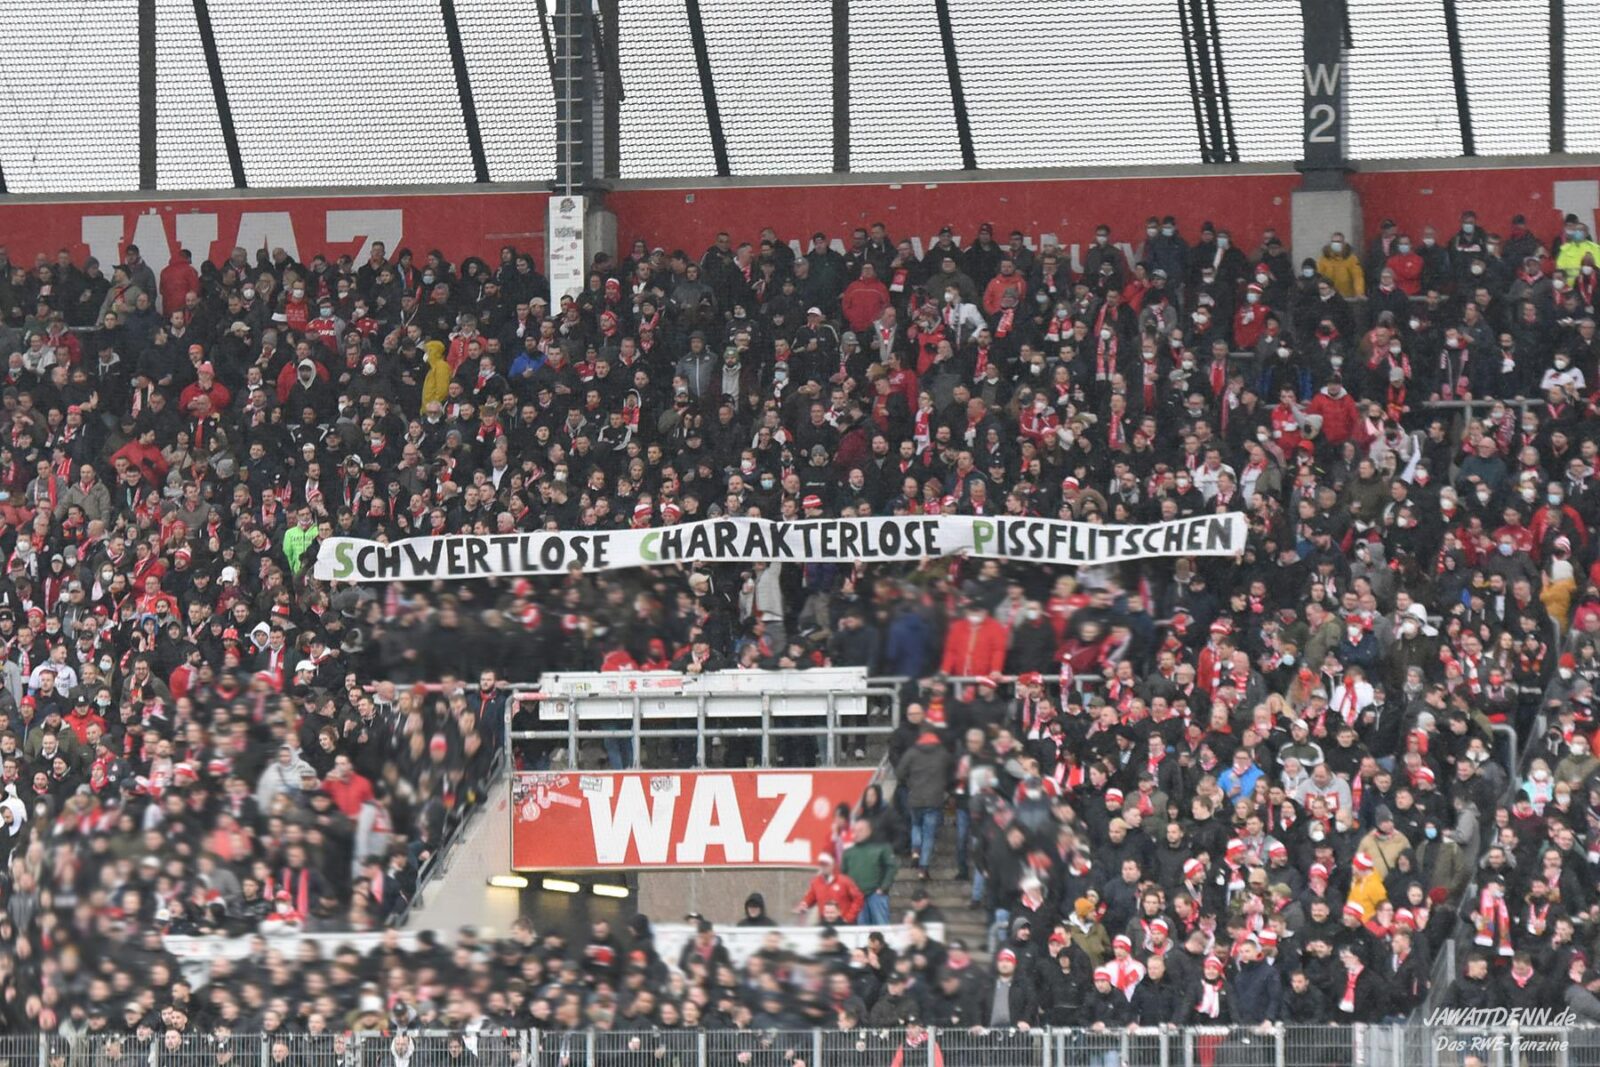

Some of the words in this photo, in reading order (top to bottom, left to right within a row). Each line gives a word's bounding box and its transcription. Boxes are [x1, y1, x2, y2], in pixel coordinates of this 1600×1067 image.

[1304, 64, 1340, 96] W
[1309, 104, 1336, 142] 2
[332, 534, 610, 579] SCHWERTLOSE
[639, 520, 942, 563] CHARAKTERLOSE
[972, 517, 1233, 560] PISSFLITSCHEN
[583, 774, 814, 864] WAZ
